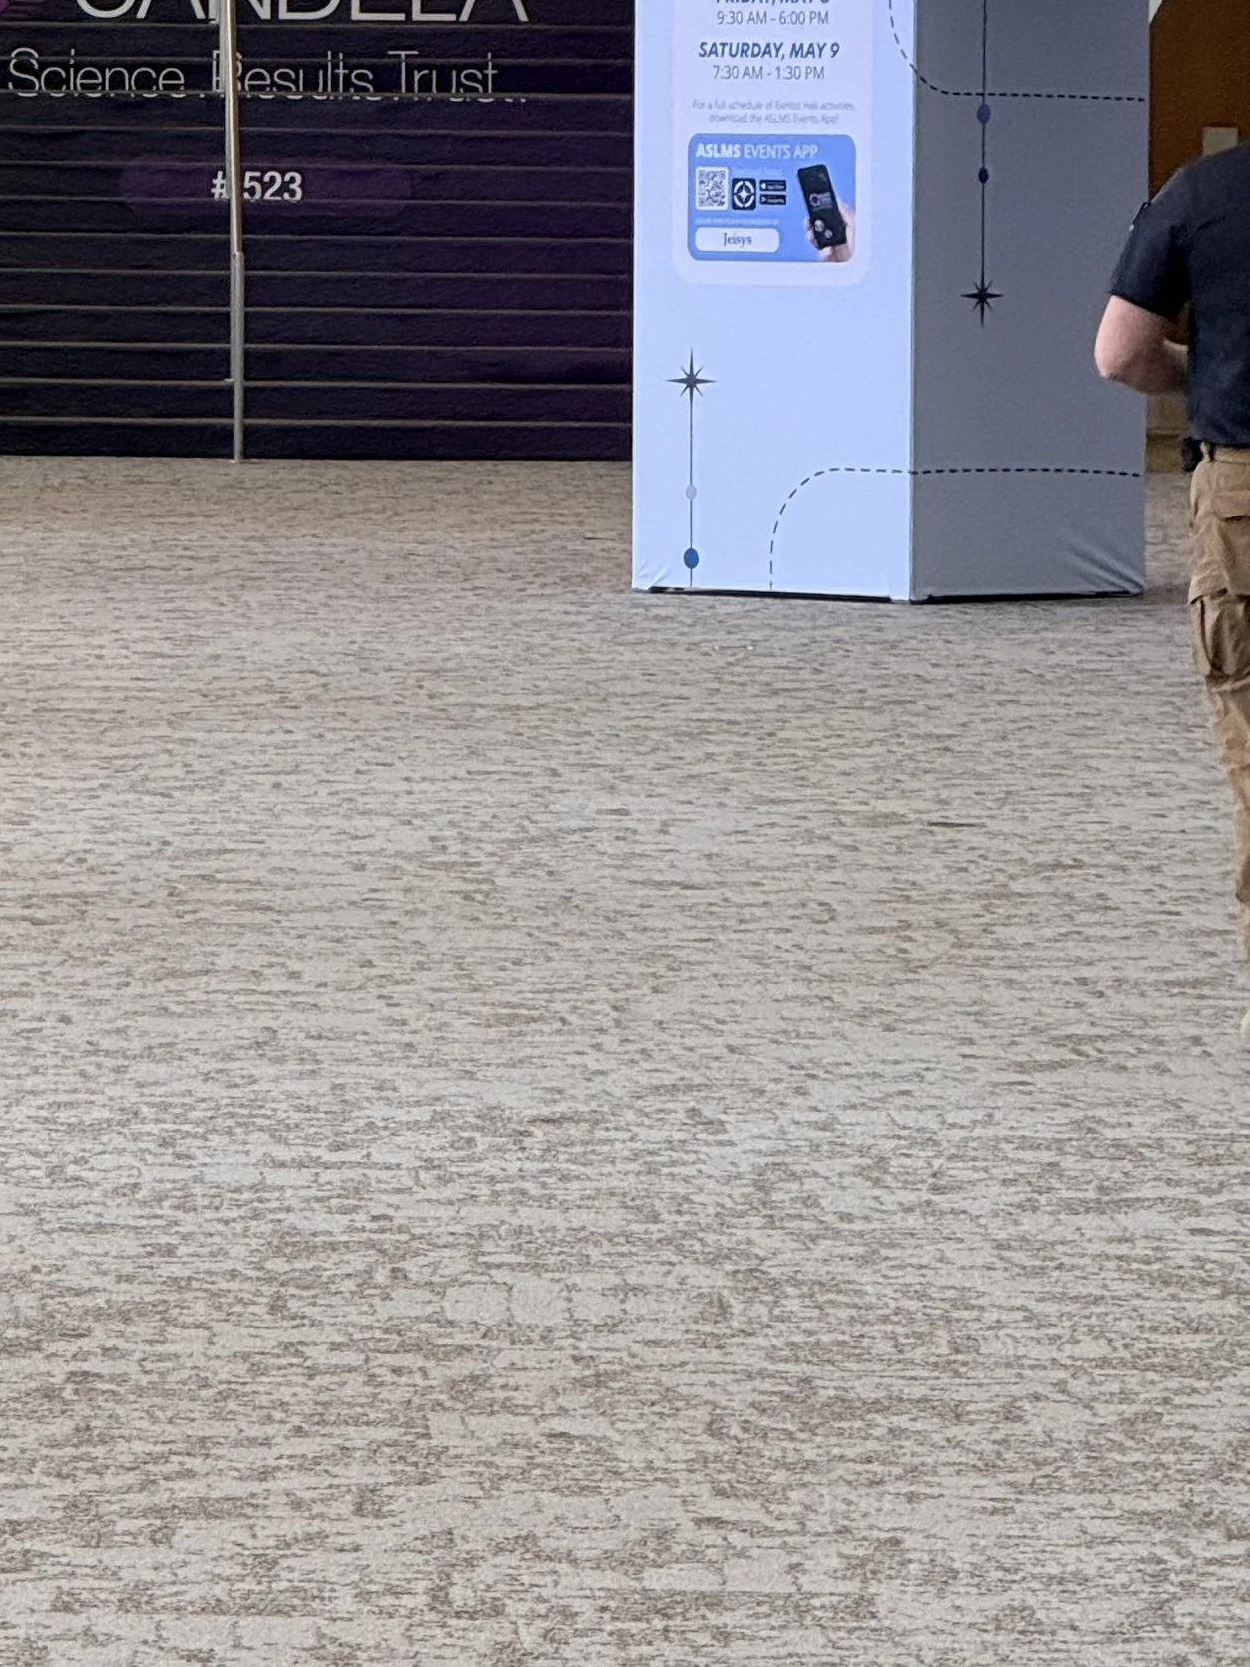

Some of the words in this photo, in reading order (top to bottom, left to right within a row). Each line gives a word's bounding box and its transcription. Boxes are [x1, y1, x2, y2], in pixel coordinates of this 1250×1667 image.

[717, 10, 744, 25] 9:30
[746, 11, 767, 25] AM
[778, 11, 806, 25] 6:00
[809, 11, 829, 25] PM
[698, 41, 785, 61] SATURDAY,
[788, 42, 827, 59] MAY
[830, 42, 841, 59] 9
[713, 65, 740, 80] 7:30
[742, 66, 763, 80] AM
[775, 66, 802, 80] 1:30
[805, 66, 825, 80] PM
[696, 143, 741, 159] ASLMS
[744, 144, 791, 159] EVENTS
[793, 144, 819, 159] APP
[211, 170, 303, 202] #523
[723, 232, 753, 247] Jeisys
